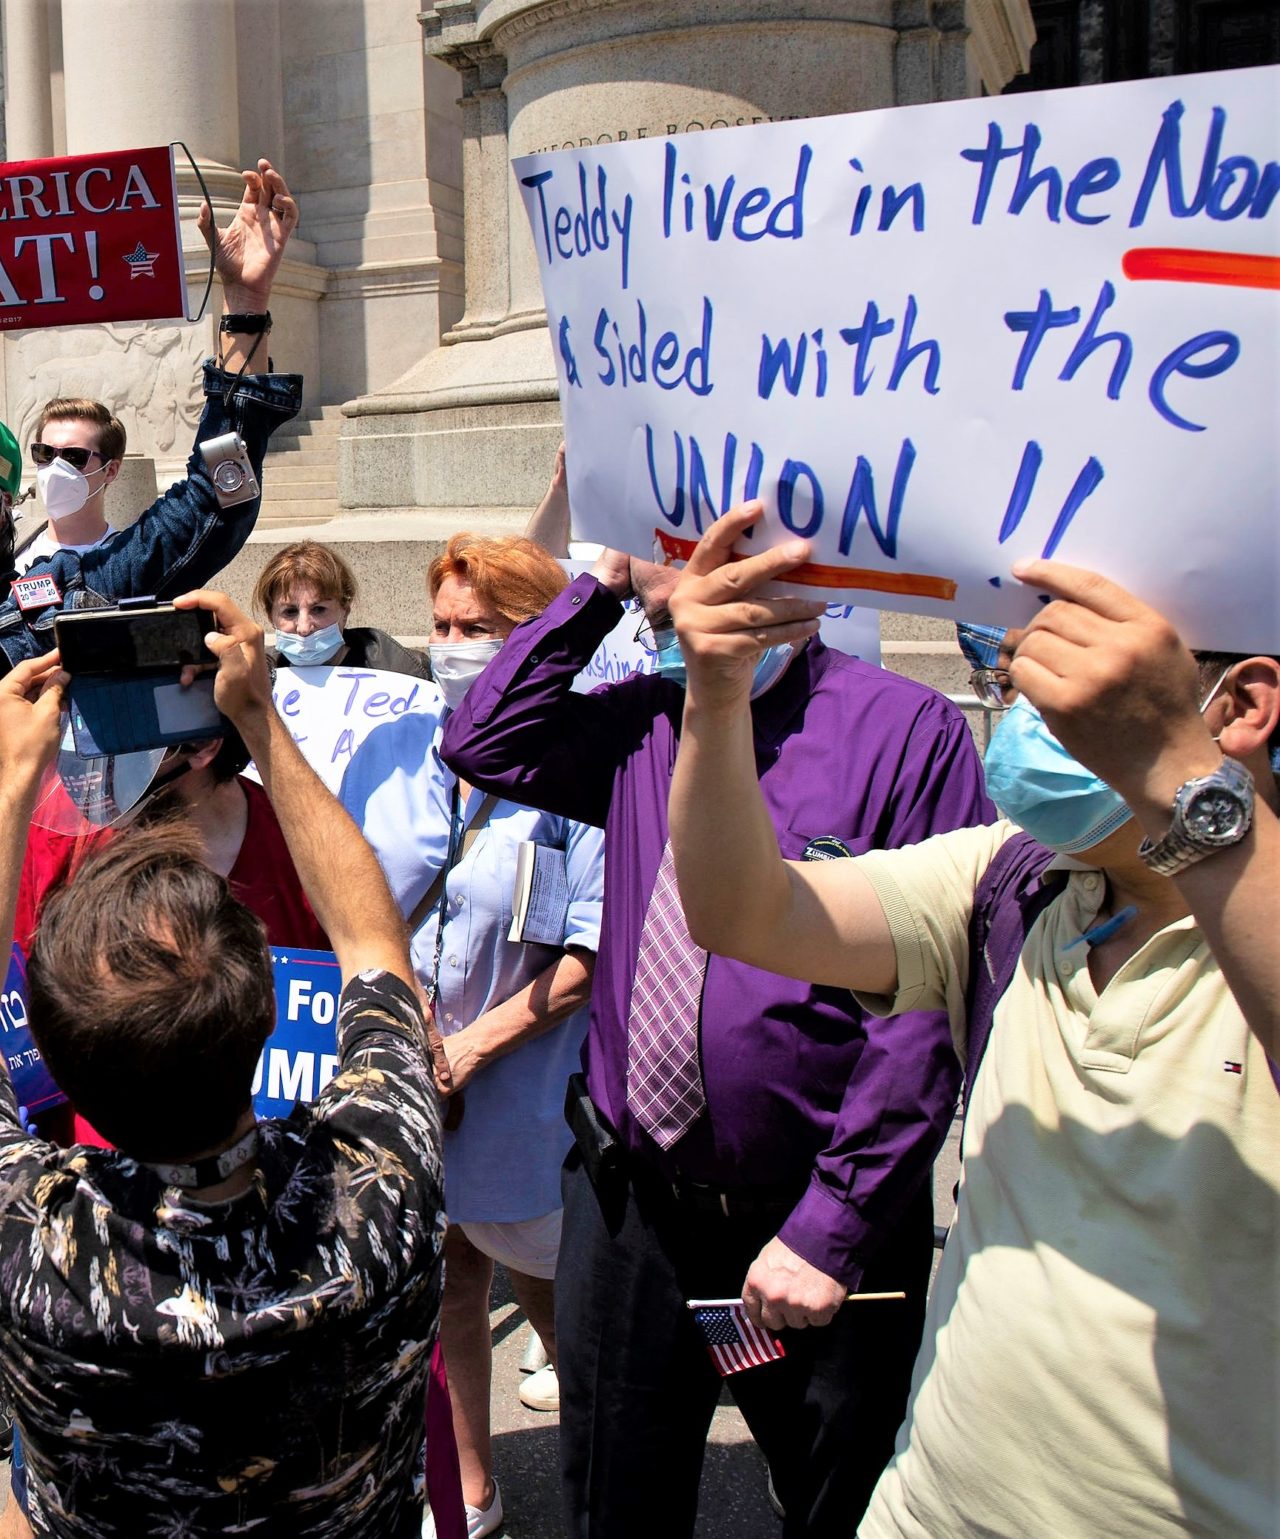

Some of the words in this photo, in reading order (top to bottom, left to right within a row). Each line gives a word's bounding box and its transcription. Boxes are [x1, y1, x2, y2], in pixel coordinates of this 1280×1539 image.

[521, 163, 632, 289] Teddy
[663, 141, 812, 241] lived
[849, 157, 925, 236] in
[960, 120, 1121, 227] the
[758, 294, 941, 400] with
[1004, 280, 1241, 433] the
[646, 423, 916, 560] UNION
[17, 579, 51, 592] TRUMP
[287, 979, 342, 1025] Fo
